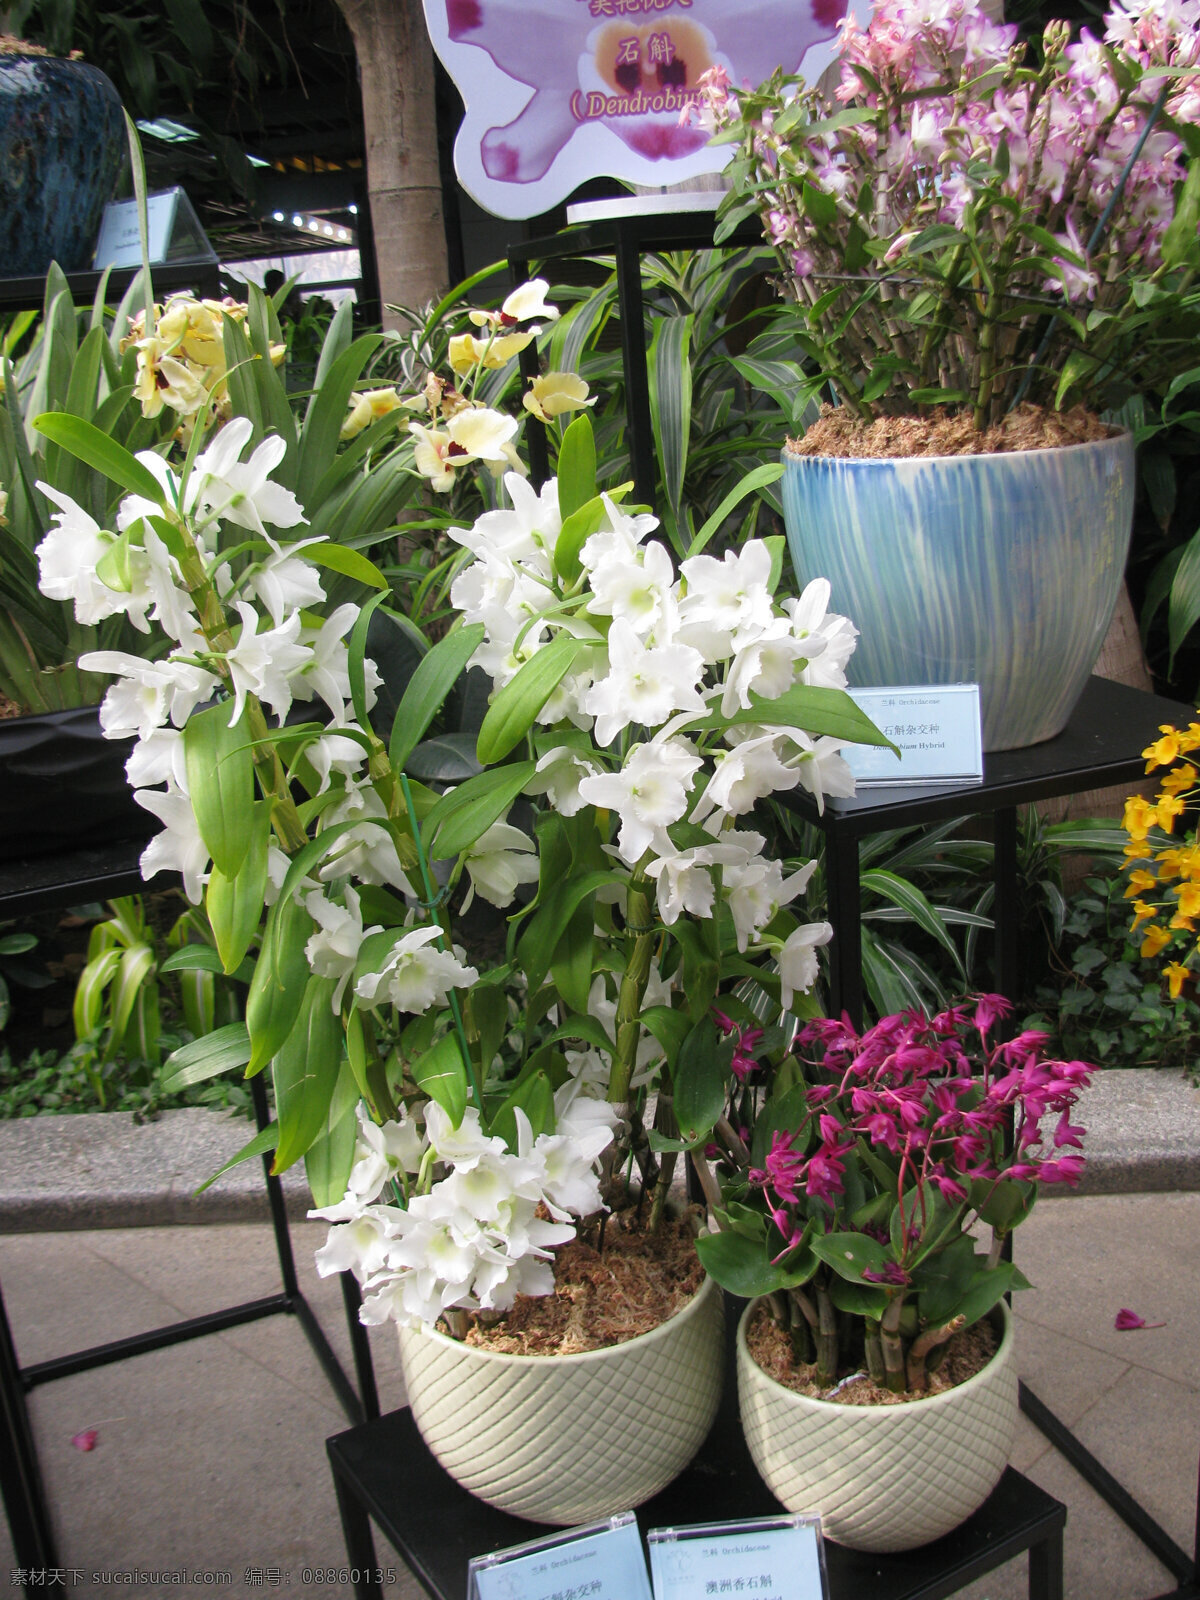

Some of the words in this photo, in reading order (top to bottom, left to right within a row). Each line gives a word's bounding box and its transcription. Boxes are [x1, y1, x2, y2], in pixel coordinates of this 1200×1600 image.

[618, 35, 673, 63] 石斛
[884, 724, 940, 736] 石斛杂交种
[919, 742, 945, 750] Hybrid
[705, 1574, 772, 1594] 澳洲香石斛
